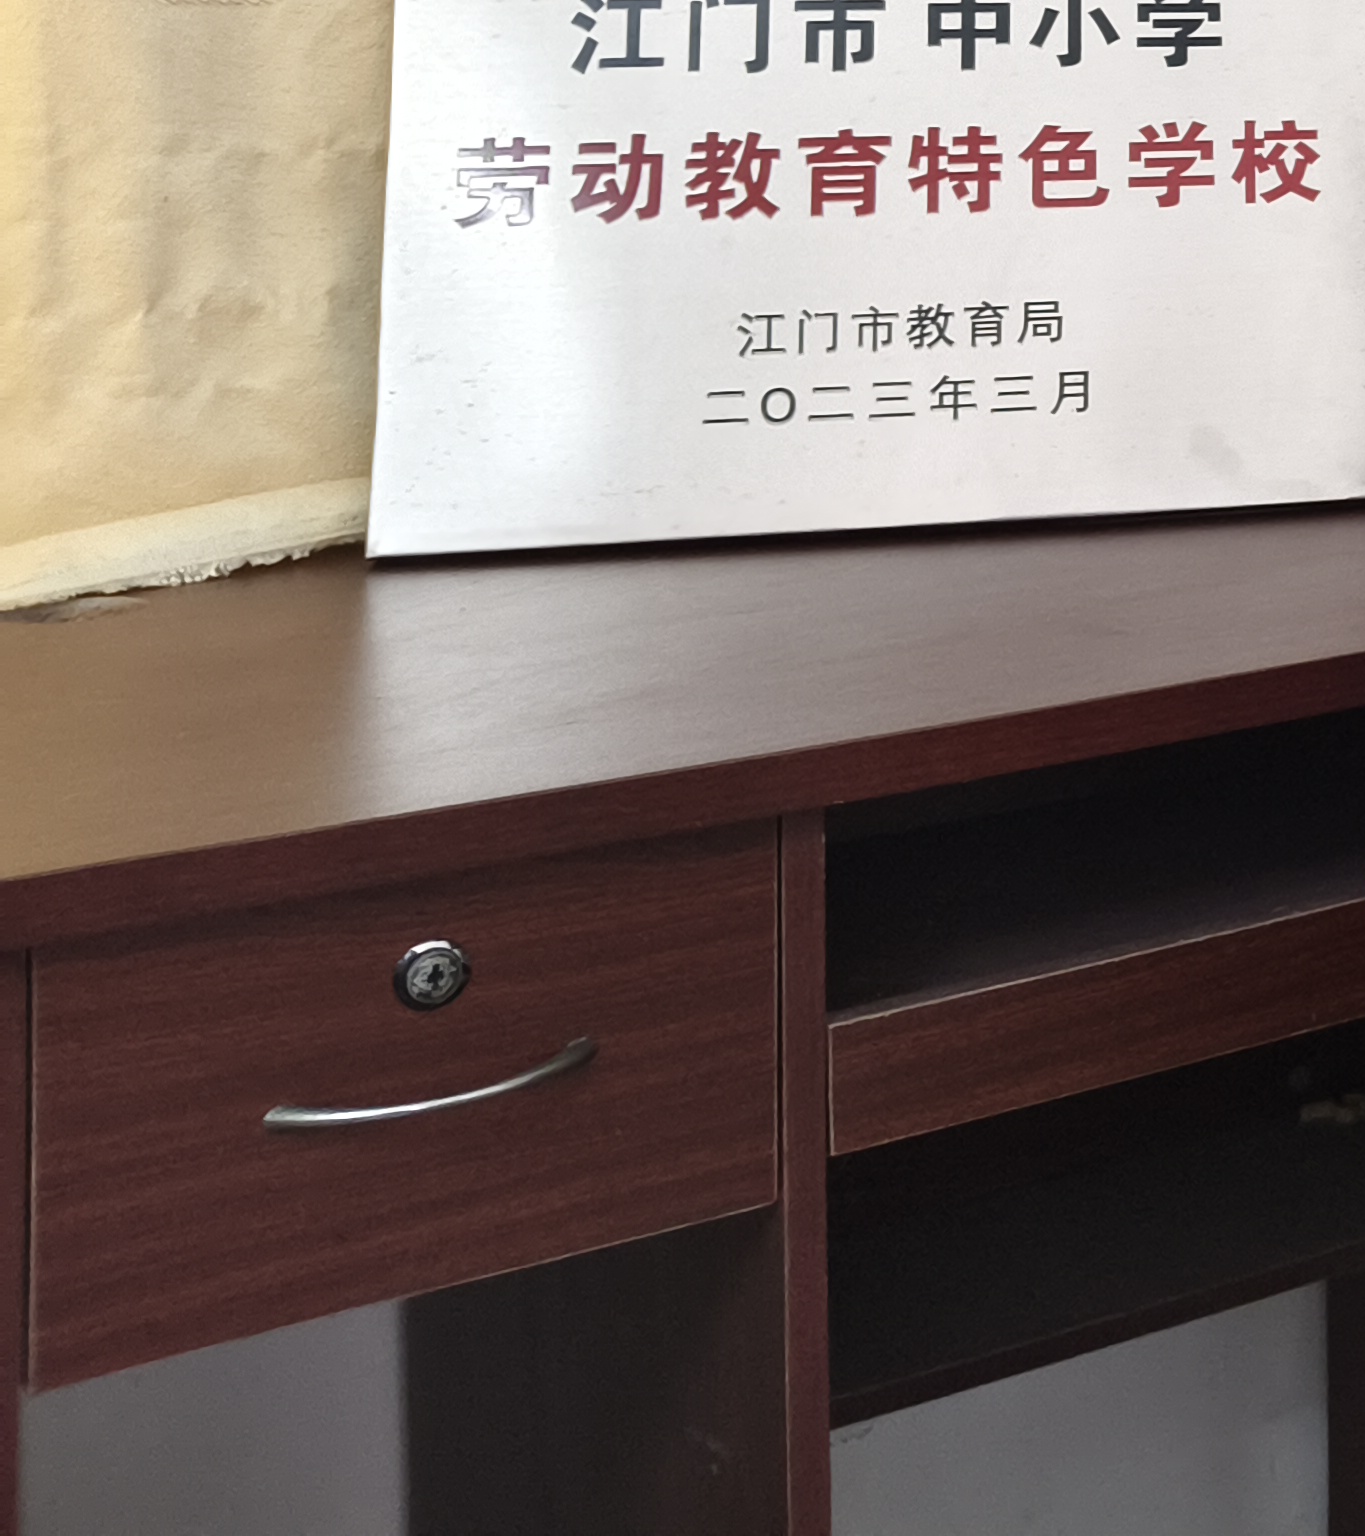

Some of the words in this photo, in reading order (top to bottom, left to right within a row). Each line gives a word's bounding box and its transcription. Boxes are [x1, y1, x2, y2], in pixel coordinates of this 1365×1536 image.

[452, 119, 1323, 229] 劳动教育特色学校
[736, 300, 1066, 358] 江门市教育局
